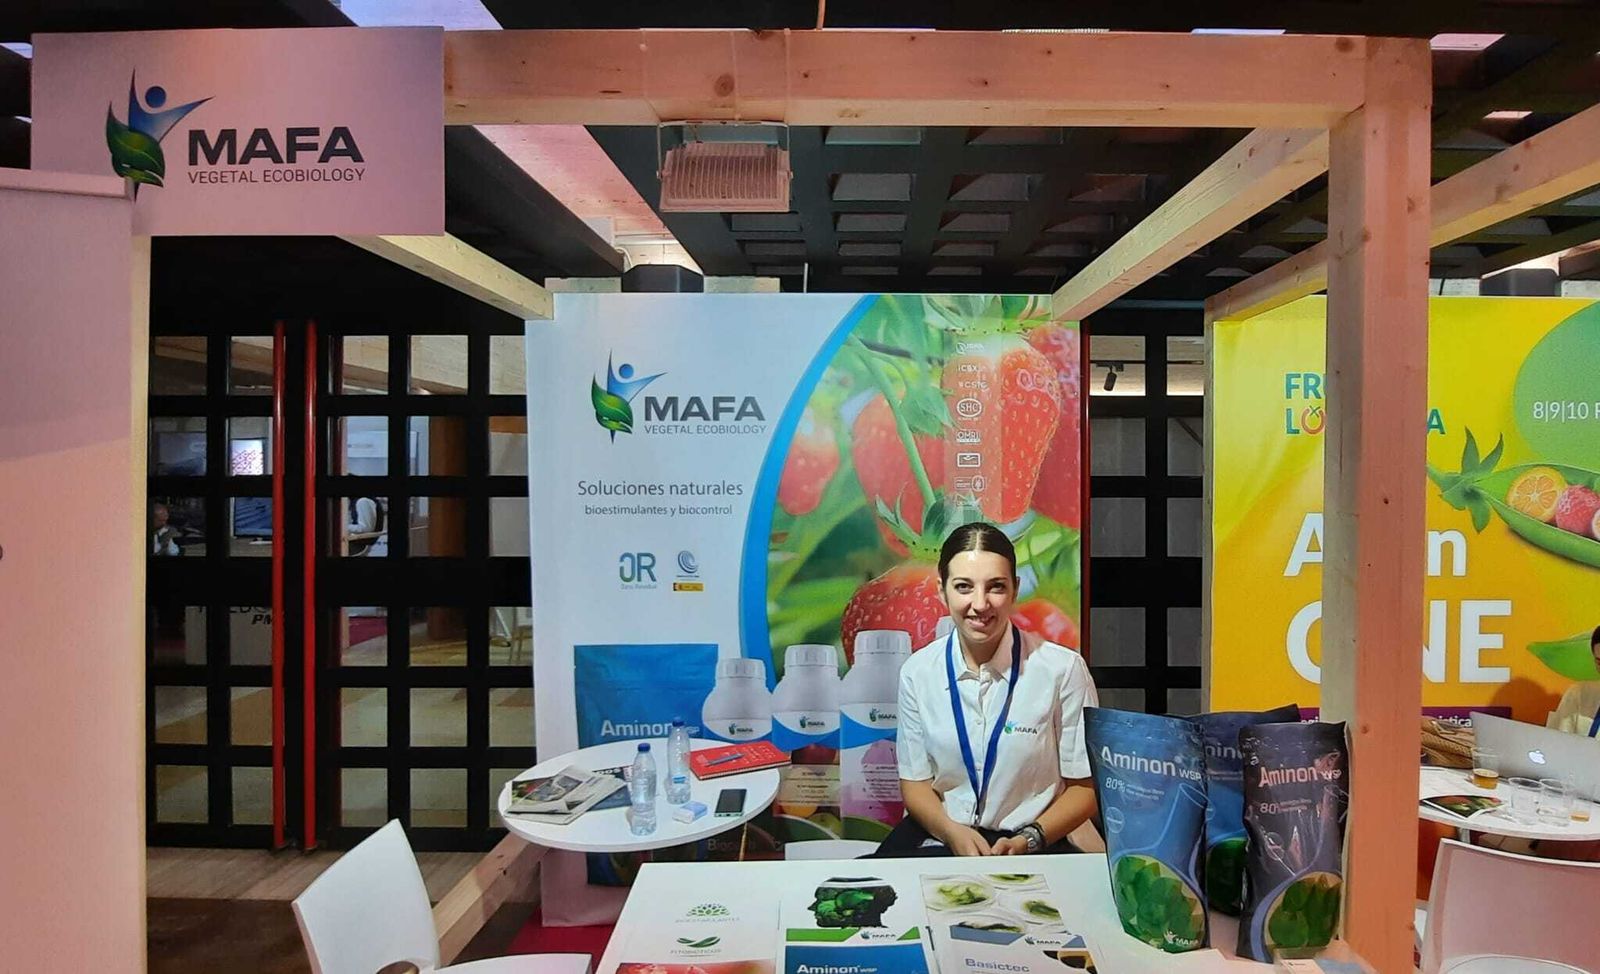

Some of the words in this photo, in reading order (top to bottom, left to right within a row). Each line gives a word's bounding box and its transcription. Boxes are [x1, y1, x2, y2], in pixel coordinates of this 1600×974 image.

[188, 126, 365, 166] MAFA
[187, 170, 259, 183] VEGETAL
[263, 168, 365, 182] ECOBIOLOGY
[1285, 373, 1327, 400] FR
[644, 396, 765, 421] MAFA
[644, 425, 693, 434] VEGETAL
[697, 424, 766, 434] ECOBIOLOGY
[578, 480, 664, 496] Soluciones
[669, 480, 743, 496] naturales
[585, 504, 668, 515] bioestimulantes
[670, 507, 675, 517] y
[679, 504, 733, 515] biocontrol
[1179, 769, 1202, 780] WSP
[1258, 763, 1318, 788] Aminon
[1105, 777, 1125, 793] 80%
[965, 958, 1030, 972] Basictec
